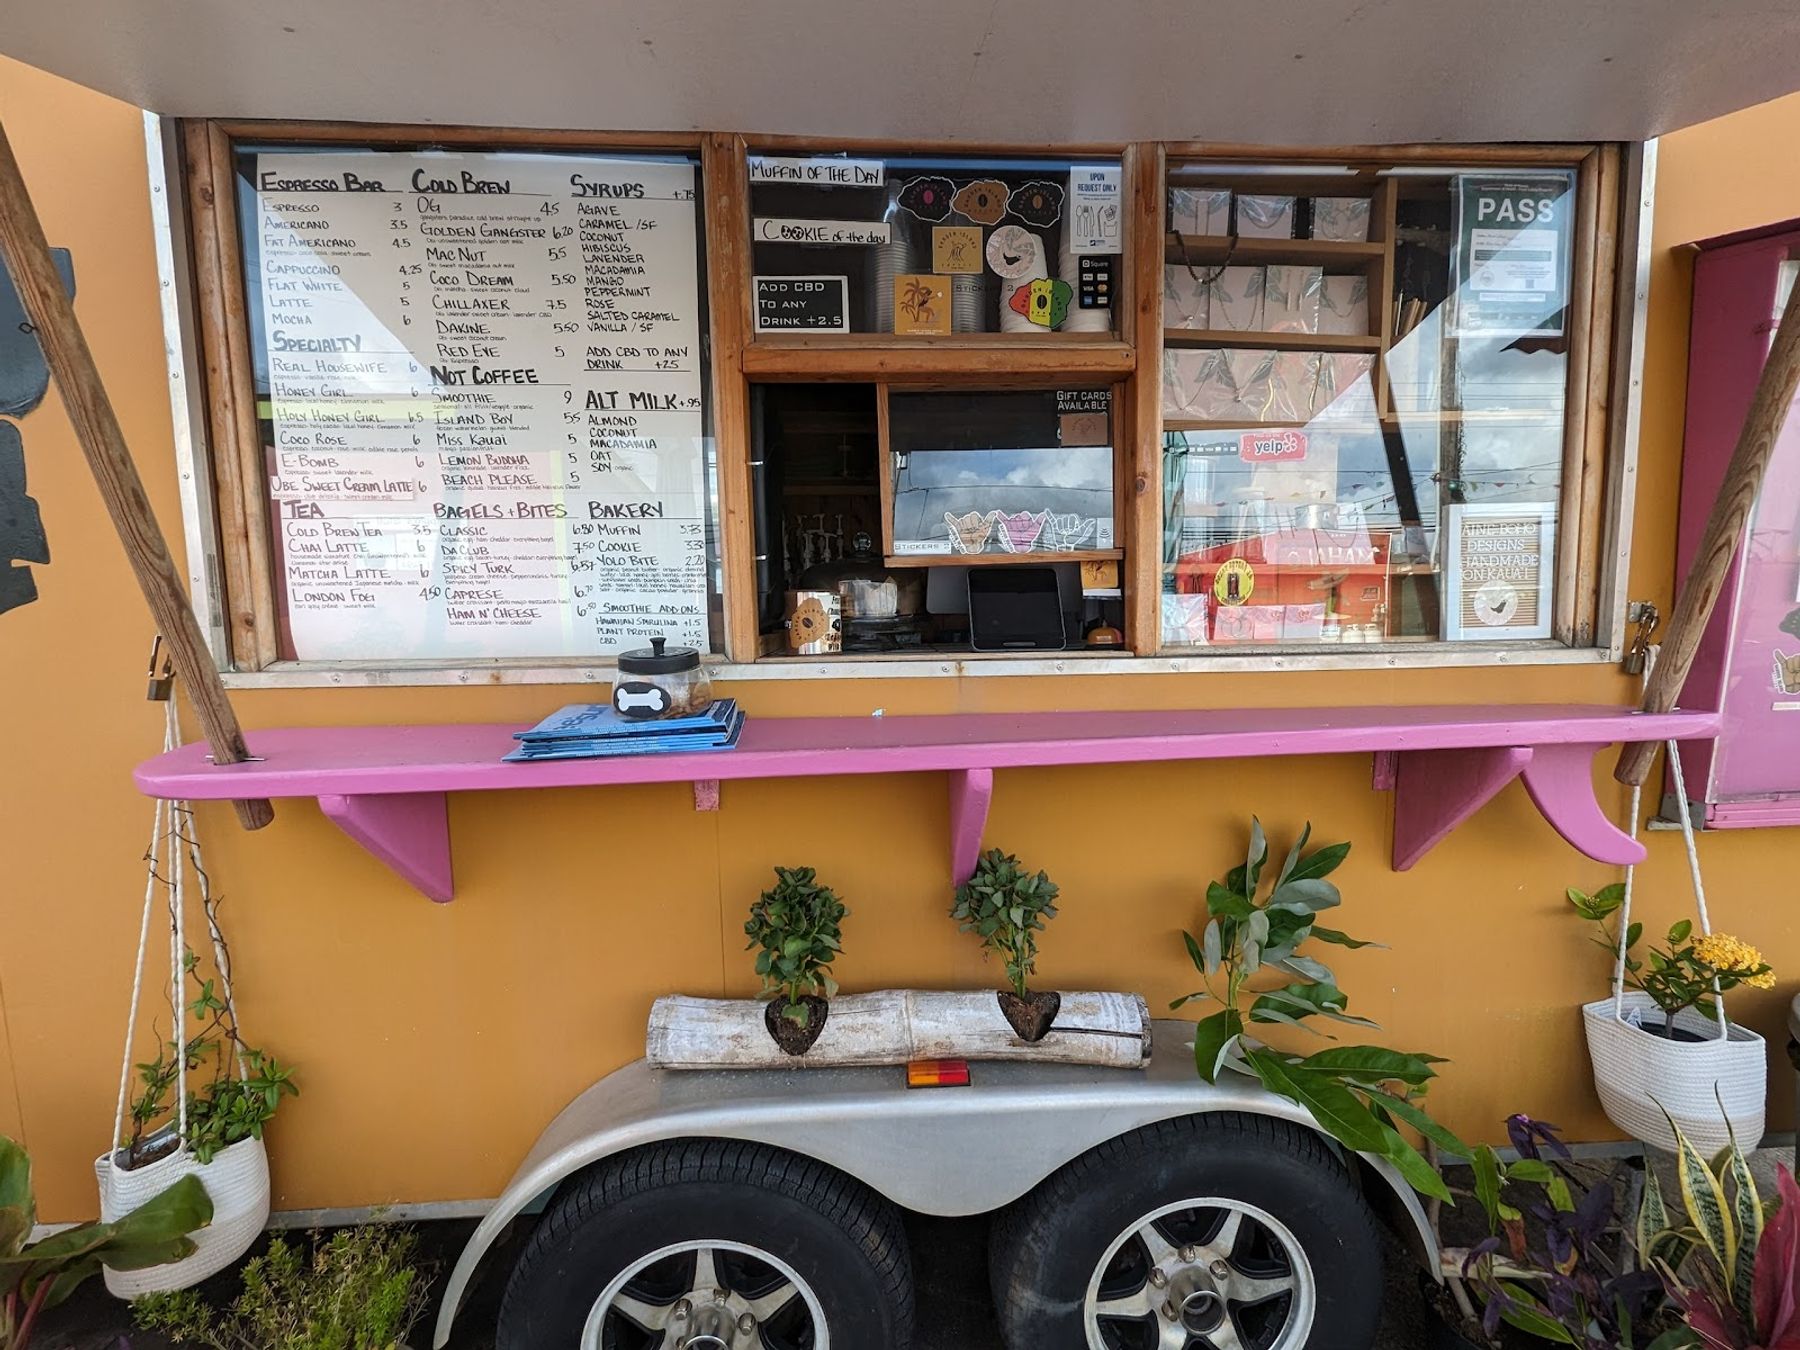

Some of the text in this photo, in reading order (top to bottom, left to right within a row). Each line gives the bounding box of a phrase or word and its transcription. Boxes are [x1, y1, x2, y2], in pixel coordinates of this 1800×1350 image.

[752, 160, 879, 184] MUFFIN OF THE DAY
[261, 172, 386, 192] ESPRESSO BAR
[412, 168, 457, 193] COLD
[570, 174, 644, 198] SYRUPS
[262, 197, 319, 212] ESPRESSO
[417, 196, 441, 213] OG
[577, 203, 620, 215] AGAVE
[1478, 198, 1554, 222] PASS
[264, 216, 407, 230] AMERICANO 3.5
[579, 219, 633, 229] CARAMEL
[420, 223, 546, 238] GOLDEN GANGSTER
[580, 231, 624, 241] COCONUT
[763, 220, 886, 243] COOKIE of the day
[265, 235, 411, 248] FAT AMERICANO 4.5
[582, 244, 631, 252] HIBISCUS
[427, 247, 487, 262] MAC NUT
[583, 254, 644, 263] LAVENDER
[266, 260, 422, 275] CAPPUCCINO 4.25
[585, 266, 646, 275] MACADAMIA
[430, 271, 576, 285] COCO DREAM 5.50
[586, 277, 624, 285] MANGO
[268, 278, 343, 292] FLAT WHITE
[759, 282, 825, 292] ADD CBD
[270, 296, 312, 308] LATTE
[432, 294, 567, 310] CHILLAXER 7.5
[585, 299, 614, 309] ROSE
[760, 299, 776, 309] TO
[272, 313, 312, 325] MOCHA
[588, 311, 680, 321] SALTED CARAMEL
[761, 316, 842, 325] DRINK +2.5
[436, 320, 491, 334] DAKINE
[587, 321, 627, 332] VANILLA
[272, 330, 361, 352] SPECIALTY
[437, 344, 501, 358] RED EYE
[586, 346, 688, 357] ADD CBD TO ANY
[273, 358, 388, 373] REAL HOUSEWIFE
[587, 360, 623, 369] DRINK
[430, 366, 539, 385] NOT COFFEE
[275, 382, 353, 397] HONEY GIRL
[432, 388, 496, 404] SMOOTHIE
[1057, 390, 1112, 400] GIFT CARDS
[586, 390, 678, 410] ALT MILK
[1057, 401, 1107, 410] AVAILABLE
[277, 408, 424, 422] HOLY HONEY GIRL 6.5
[434, 411, 513, 425] ISLAND BOY
[588, 415, 636, 426] ALMOND
[280, 431, 348, 445] COCO ROSE
[590, 428, 638, 438] COCONUT
[590, 439, 657, 449] MACADAMIA
[1255, 439, 1283, 455] yelp
[282, 454, 339, 467] E-BOMB
[438, 453, 530, 466] LEMON BUDDHA
[590, 450, 612, 461] OAT
[591, 462, 612, 472] SOY
[271, 476, 413, 492] UBE SWEET CREAM LATTE
[441, 474, 537, 485] BEACH PLEASE
[283, 501, 324, 518] TEA
[433, 503, 504, 518] BAGELS
[516, 502, 567, 518] BITES
[589, 501, 664, 518] BAKERY
[287, 522, 319, 537] COLD
[357, 522, 383, 536] TEA
[440, 525, 488, 536] CLASSIC
[597, 524, 641, 535] MUFFIN
[288, 539, 369, 552] CHAI LATTE
[441, 545, 489, 555] DA CLUB
[598, 540, 641, 552] COOKIE
[1468, 539, 1525, 552] DESIGNS
[597, 556, 658, 566] YOLO BITE
[289, 566, 391, 579] MATCHA LATTE
[442, 562, 514, 574] SPICY TURK
[292, 589, 375, 601] LONDON FOG
[445, 588, 504, 599] CAPRESE
[447, 608, 475, 619] HAM
[493, 608, 541, 618] CHEESE
[603, 603, 651, 612] SMOOTHIE
